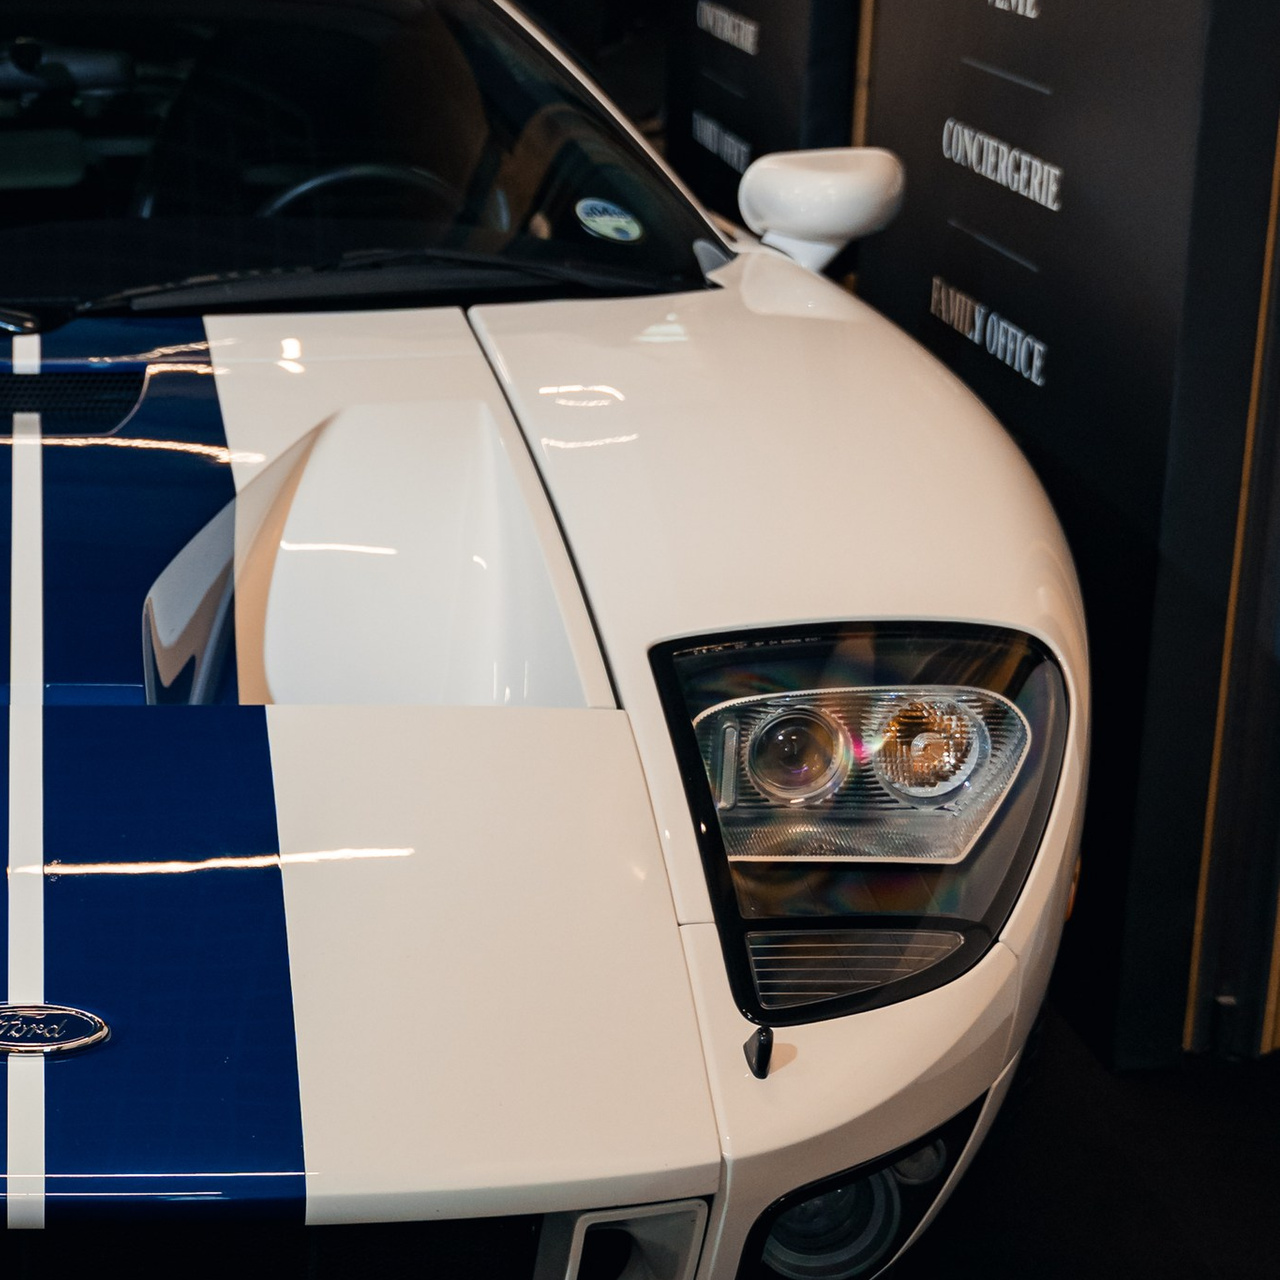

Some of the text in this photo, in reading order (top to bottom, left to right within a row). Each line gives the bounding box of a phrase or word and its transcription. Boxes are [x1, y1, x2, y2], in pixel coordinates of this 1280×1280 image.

[942, 117, 1063, 212] CONCIERGERIE
[930, 275, 1047, 387] FAMILY OFFICE
